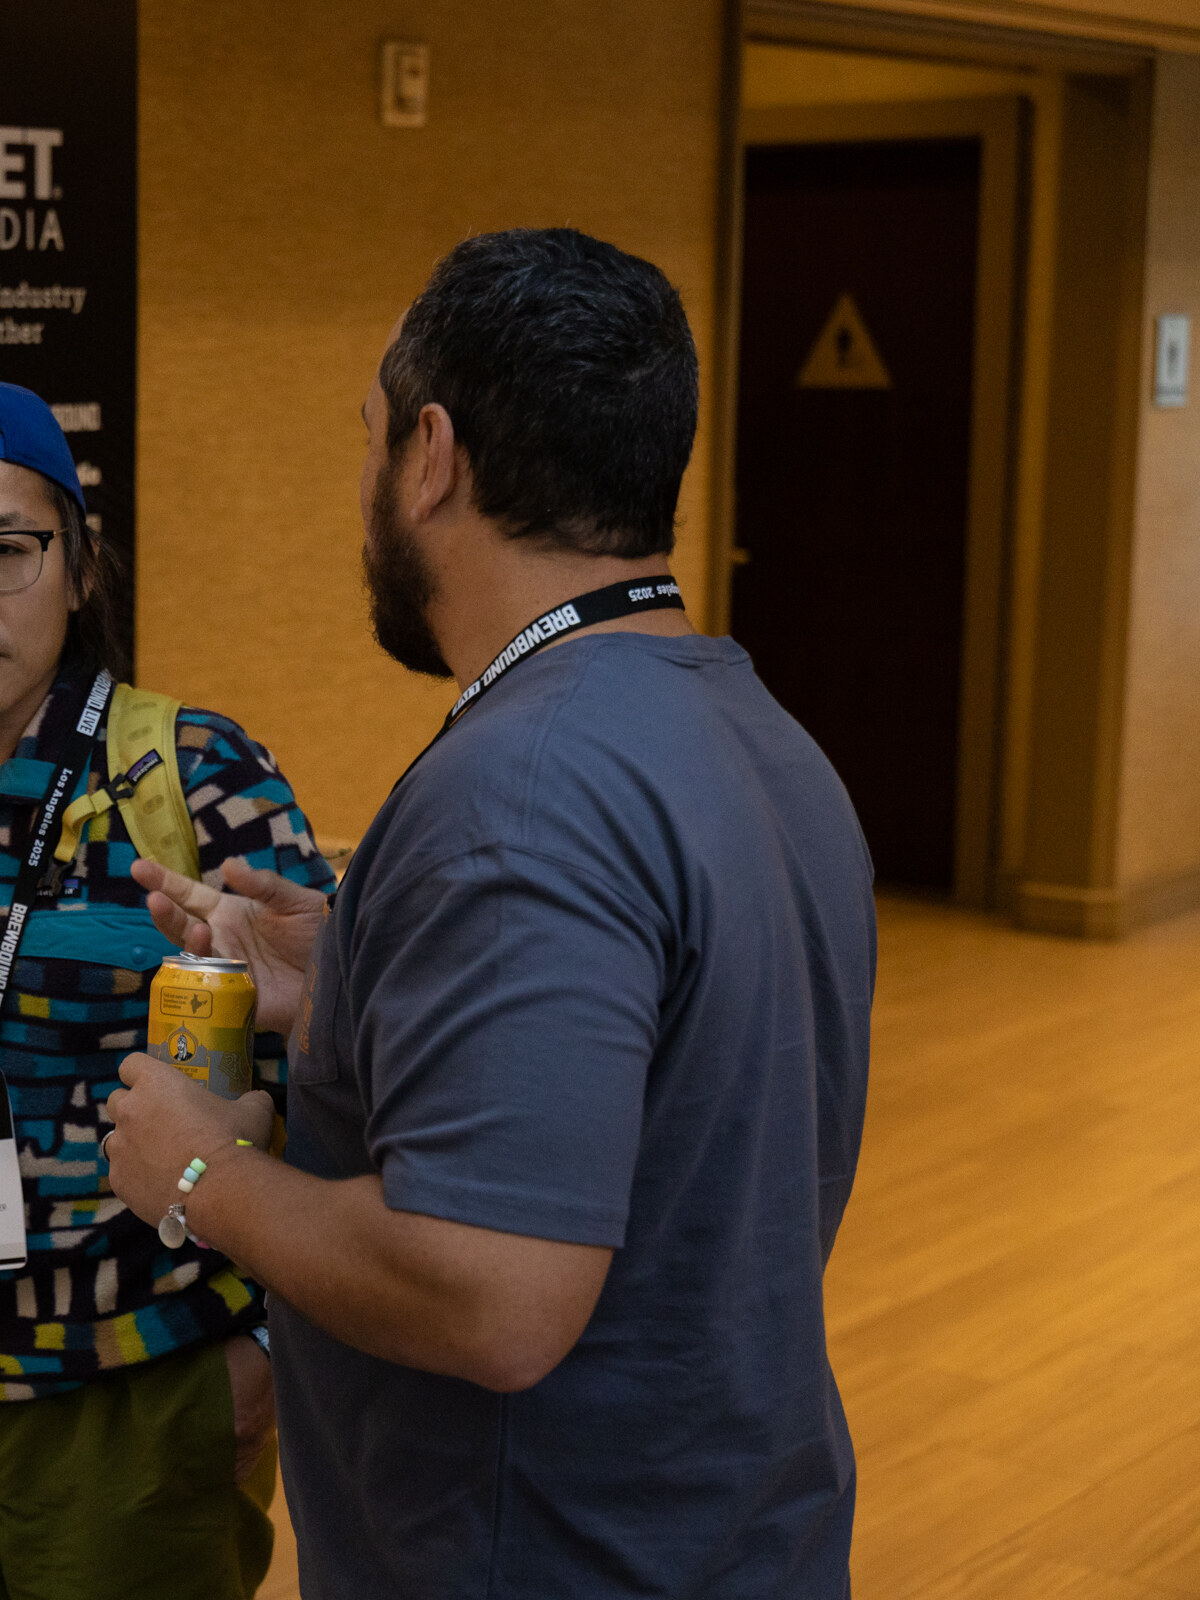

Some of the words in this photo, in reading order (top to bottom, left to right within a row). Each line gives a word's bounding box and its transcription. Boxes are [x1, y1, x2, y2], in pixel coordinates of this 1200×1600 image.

[628, 585, 655, 602] 2025
[78, 711, 100, 736] LIVE
[57, 768, 73, 788] Los
[38, 787, 63, 835] Angeles
[28, 834, 46, 867] 2025
